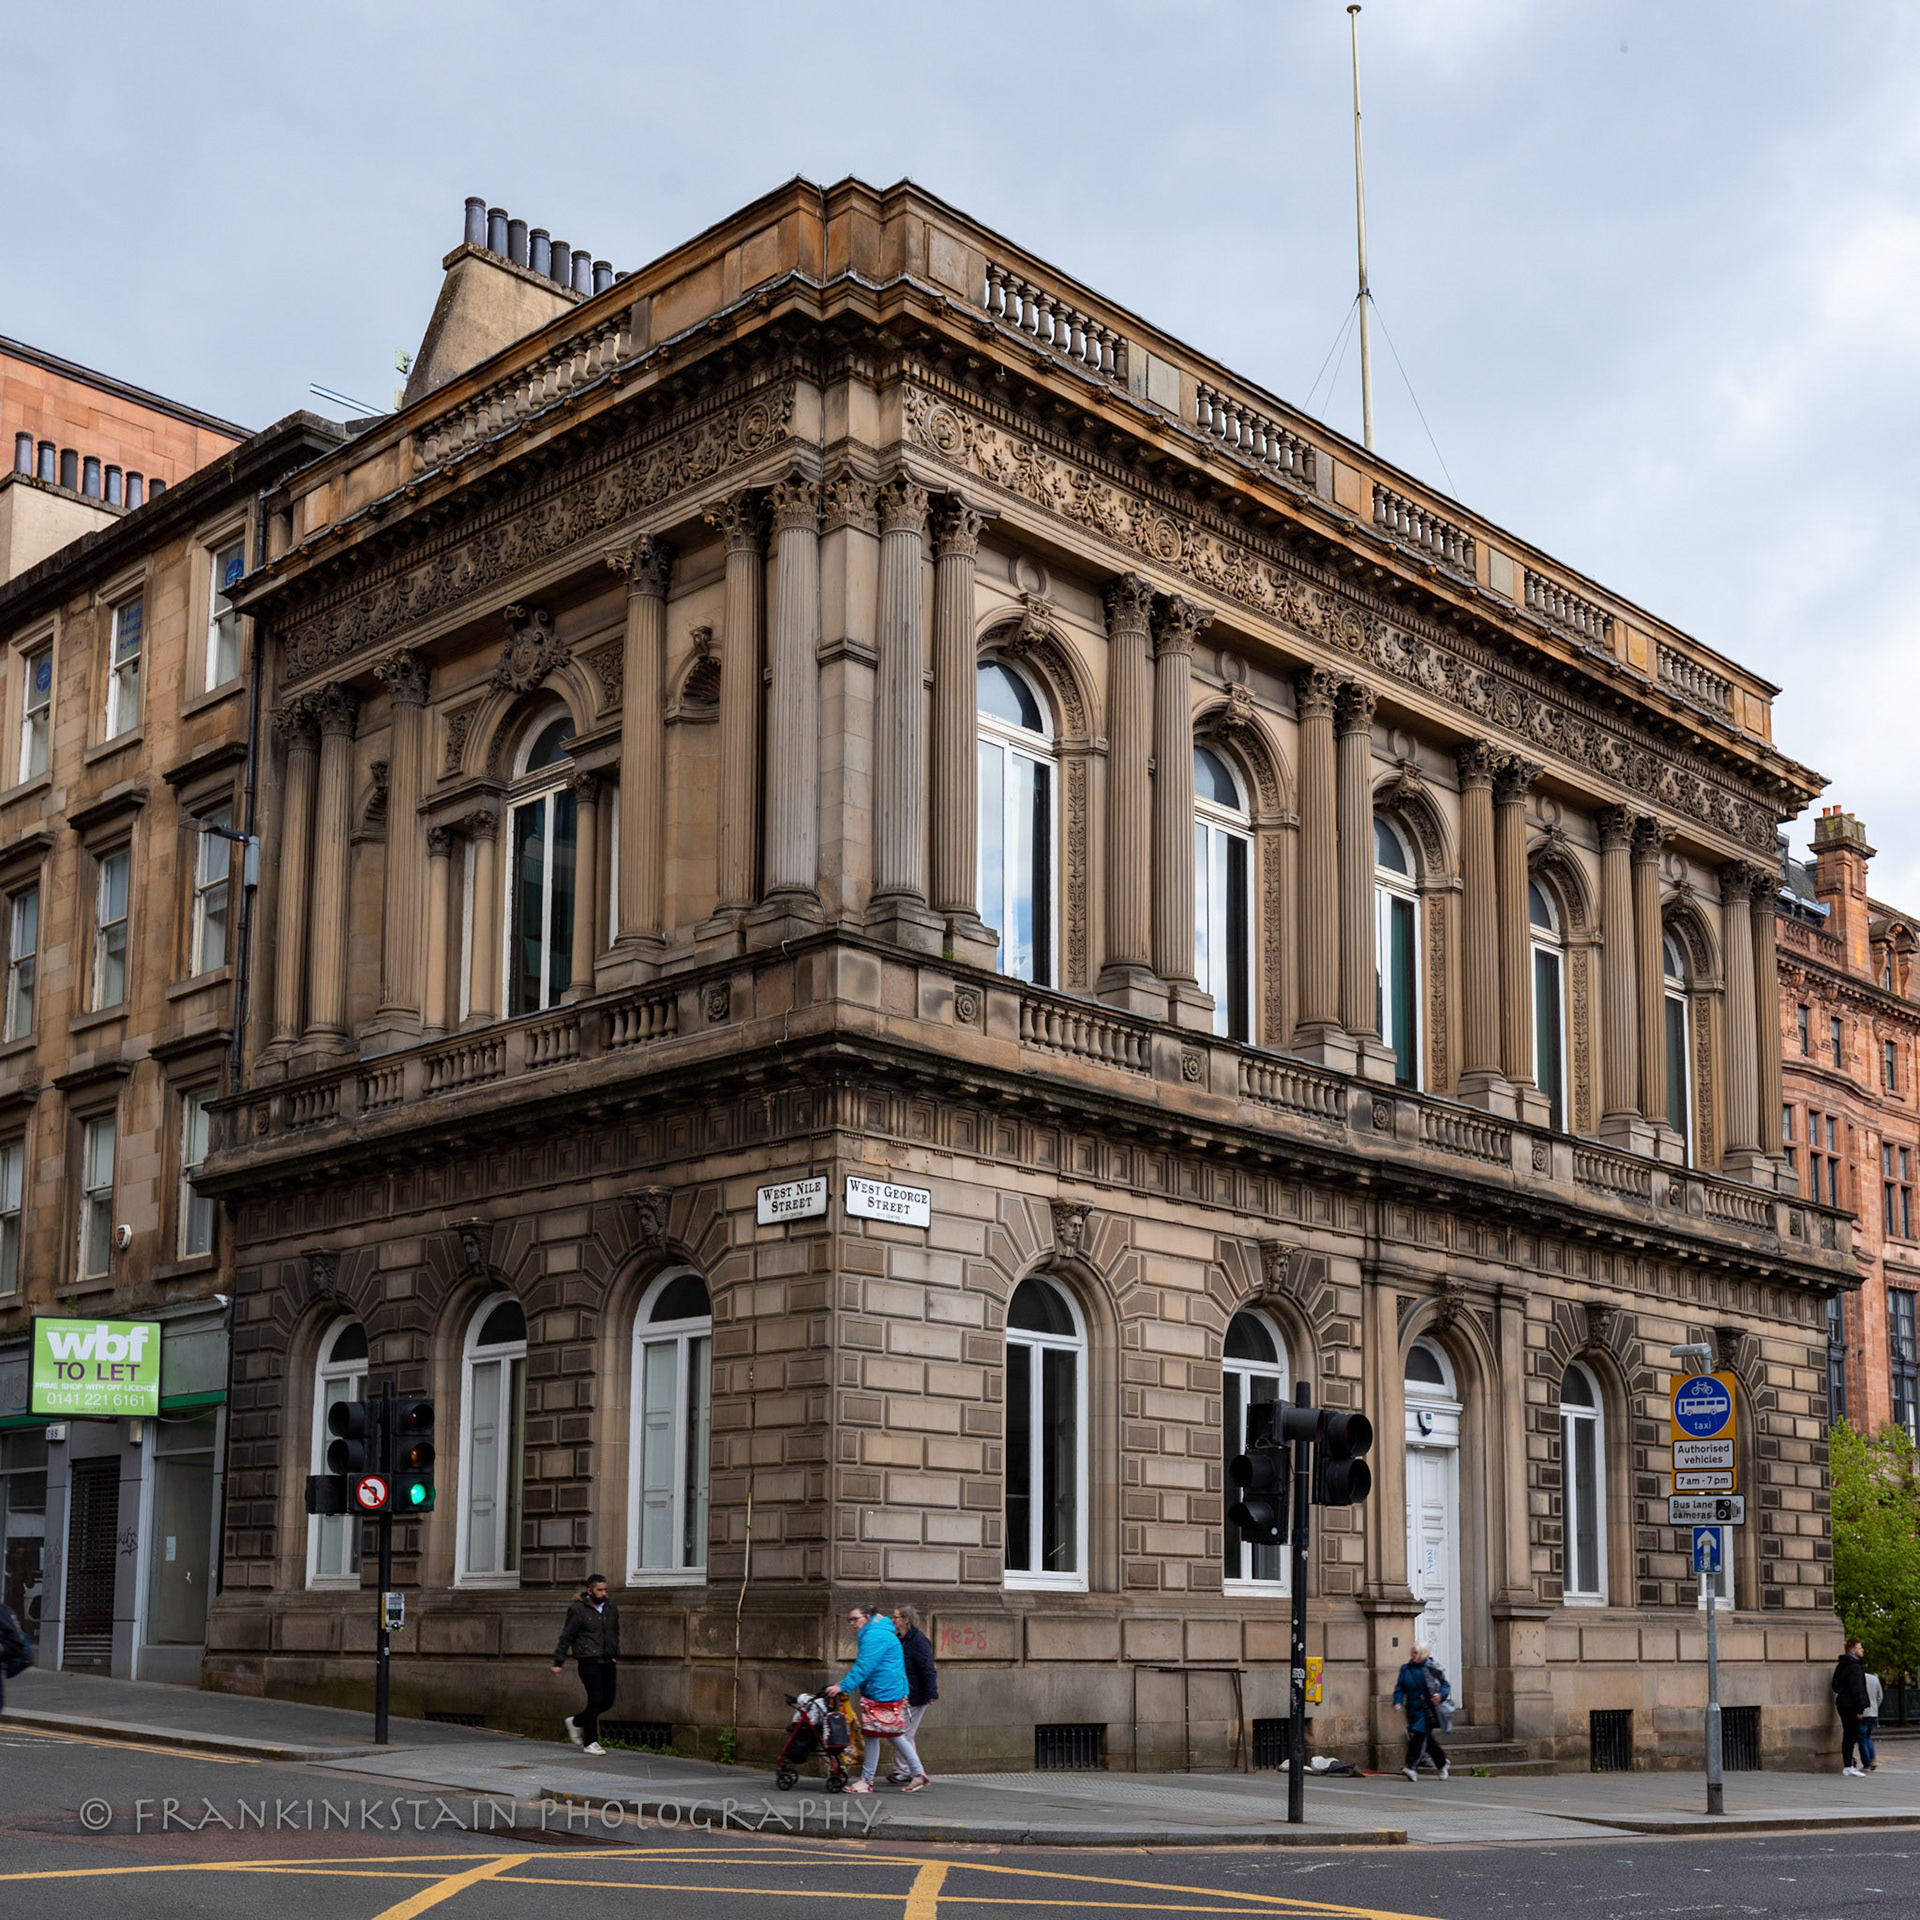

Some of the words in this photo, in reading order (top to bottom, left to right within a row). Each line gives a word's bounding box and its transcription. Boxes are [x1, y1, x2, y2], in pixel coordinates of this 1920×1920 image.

[763, 1186, 792, 1201] WEST
[796, 1181, 822, 1195] NILE
[849, 1179, 882, 1196] WEST
[884, 1185, 928, 1204] GEORGE
[771, 1197, 813, 1213] STREET
[867, 1196, 911, 1215] STREET
[46, 1324, 149, 1362] wbf
[53, 1361, 85, 1380] TO
[97, 1363, 140, 1382] LET
[35, 1381, 58, 1390] PRIME
[61, 1382, 83, 1391] SHOP
[85, 1383, 105, 1391] WITH
[107, 1383, 122, 1391] OFF
[124, 1384, 157, 1392] LICENCE
[47, 1392, 80, 1405] 0141
[84, 1393, 108, 1406] 221
[113, 1394, 145, 1407] 6161
[1694, 1421, 1712, 1430] taxi
[1677, 1444, 1730, 1454] Authorised
[1684, 1455, 1723, 1464] vehicles
[1679, 1476, 1685, 1485] 7
[1707, 1476, 1713, 1484] 7
[1714, 1477, 1729, 1486] pm
[1673, 1500, 1690, 1509] Bus
[1693, 1500, 1713, 1509] lane
